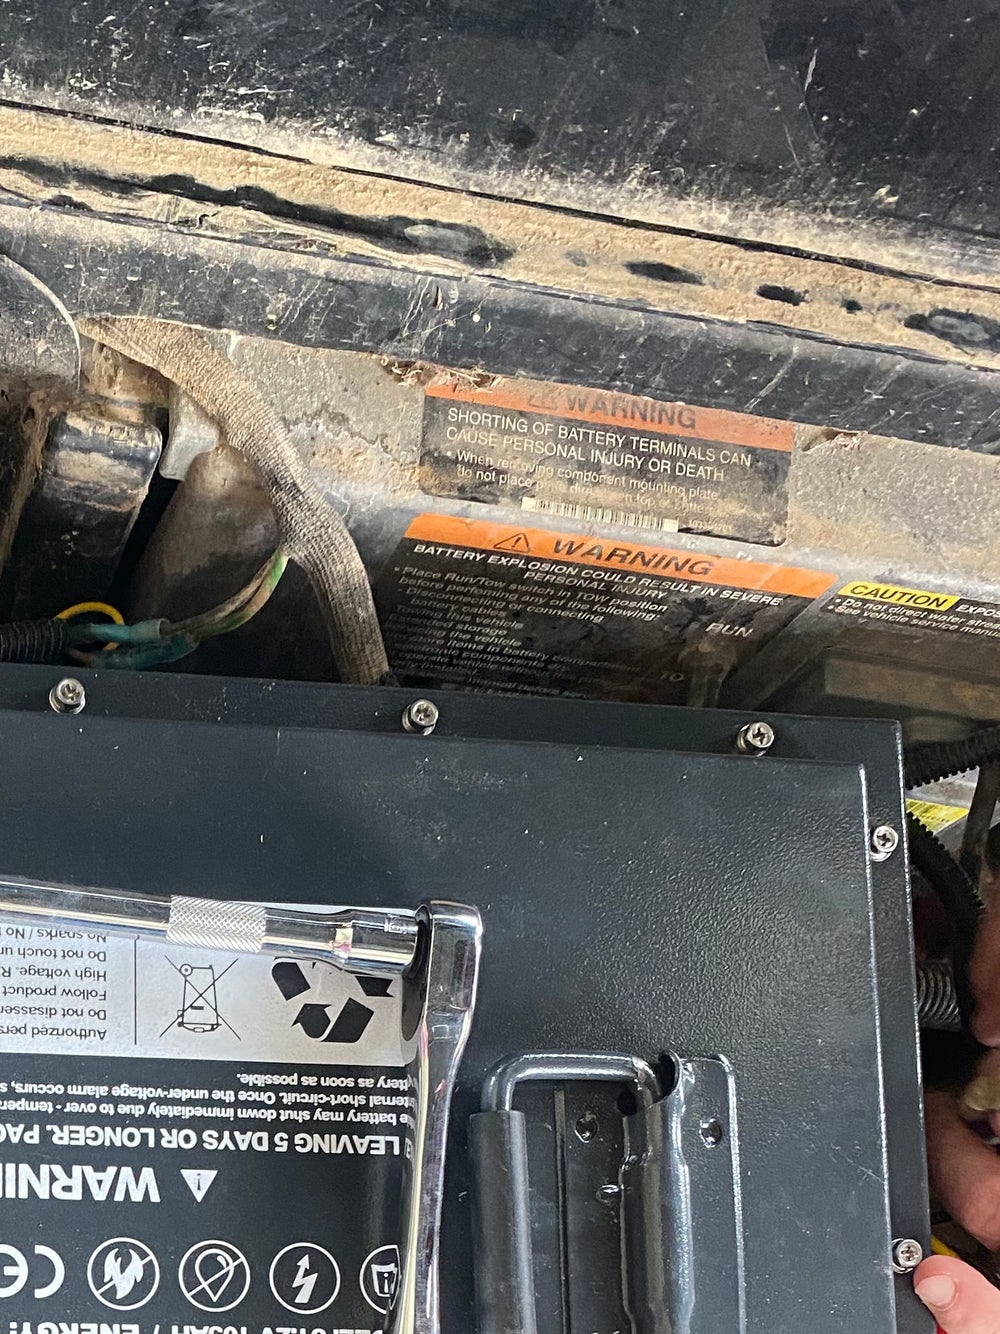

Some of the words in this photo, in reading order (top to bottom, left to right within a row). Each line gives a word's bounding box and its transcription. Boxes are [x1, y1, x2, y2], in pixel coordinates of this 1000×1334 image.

[567, 396, 695, 429] WARNING
[448, 407, 527, 431] SHORTING
[532, 421, 553, 435] OF
[558, 425, 625, 448] BATTERY
[629, 436, 714, 461] TERMINALS
[719, 450, 750, 469] CAN
[447, 426, 496, 445] CAUSE
[503, 436, 585, 460] PERSONAL
[590, 449, 643, 470] INJURY
[648, 456, 670, 474] OR
[675, 461, 723, 481] DEATH
[553, 539, 713, 574] WARNING
[413, 544, 485, 560] BATTERY
[487, 555, 578, 574] EXPLOSION
[581, 569, 635, 583] COULD
[638, 578, 701, 592] RESULT
[700, 587, 719, 595] IN
[719, 590, 782, 605] SEVERE
[399, 576, 443, 588] before
[402, 566, 440, 577] Place
[444, 573, 505, 587] Run/Tow
[509, 584, 553, 594] switch
[557, 589, 570, 597] in
[576, 592, 609, 604] TOW
[608, 598, 673, 611] position
[523, 571, 605, 589] PERSONAL
[611, 584, 667, 598] INJURY
[850, 585, 948, 607] CAUTION
[834, 605, 860, 614] See
[863, 610, 908, 622] vehicle
[910, 618, 958, 629] service
[841, 598, 861, 607] Do
[888, 606, 927, 617] direct
[927, 613, 965, 623] water
[705, 623, 753, 636] RUN
[5, 927, 24, 938] No
[36, 928, 83, 940] sparks
[17, 947, 56, 958] touch
[61, 949, 83, 959] not
[88, 950, 106, 961] Do
[16, 964, 70, 979] voltage.
[75, 966, 106, 981] High
[2, 985, 56, 997] product
[60, 988, 106, 1000] Follow
[61, 1008, 83, 1018] not
[88, 1008, 106, 1020] Do
[31, 1024, 106, 1040] Authorized
[236, 1073, 297, 1086] possible.
[300, 1076, 317, 1085] as
[320, 1077, 354, 1086] soon
[357, 1078, 374, 1087] as
[11, 1080, 64, 1094] occurs,
[67, 1085, 108, 1098] alarm
[111, 1083, 208, 1100] under-voltage
[211, 1089, 235, 1102] the
[237, 1090, 275, 1104] Once
[278, 1092, 365, 1107] short-circuit.
[63, 1102, 96, 1112] over
[99, 1103, 114, 1115] to
[117, 1104, 144, 1117] due
[147, 1101, 233, 1120] immediately
[313, 1108, 343, 1120] may
[237, 1108, 276, 1121] down
[279, 1109, 310, 1122] shut
[347, 1109, 396, 1125] battery
[46, 1125, 154, 1147] LONGER.
[160, 1128, 196, 1148] OR
[202, 1130, 268, 1150] DAYS
[274, 1132, 288, 1151] 5
[294, 1133, 399, 1154] LEAVING
